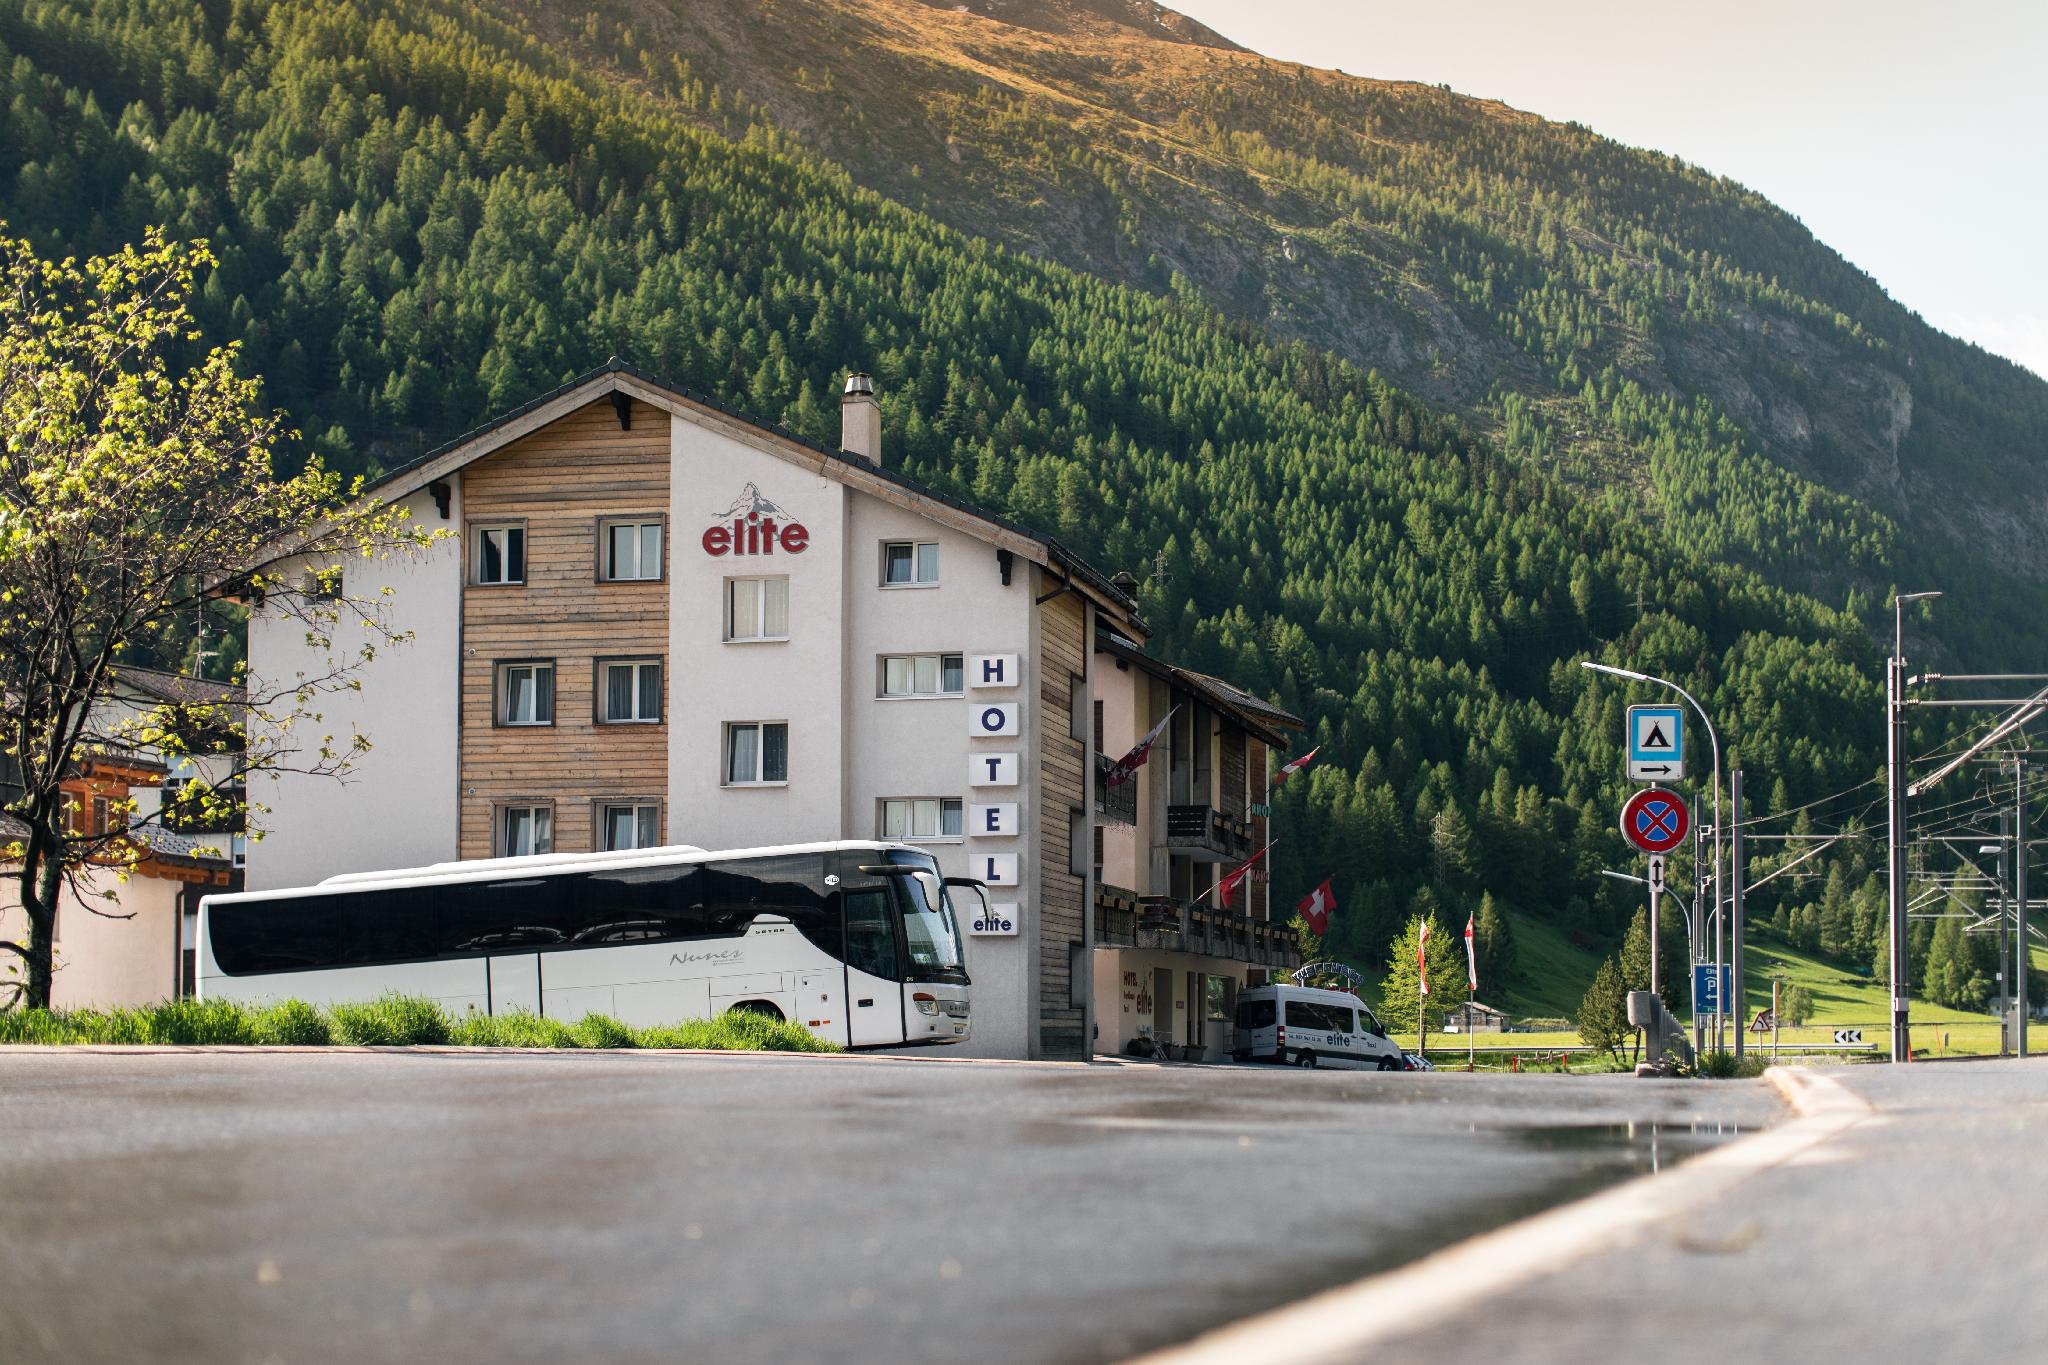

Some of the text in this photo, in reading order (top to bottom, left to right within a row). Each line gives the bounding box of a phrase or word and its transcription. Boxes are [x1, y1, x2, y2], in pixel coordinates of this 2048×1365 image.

[702, 511, 809, 557] elite
[981, 659, 1006, 881] HOTEL
[974, 915, 1012, 931] elite
[1326, 1032, 1351, 1047] elite
